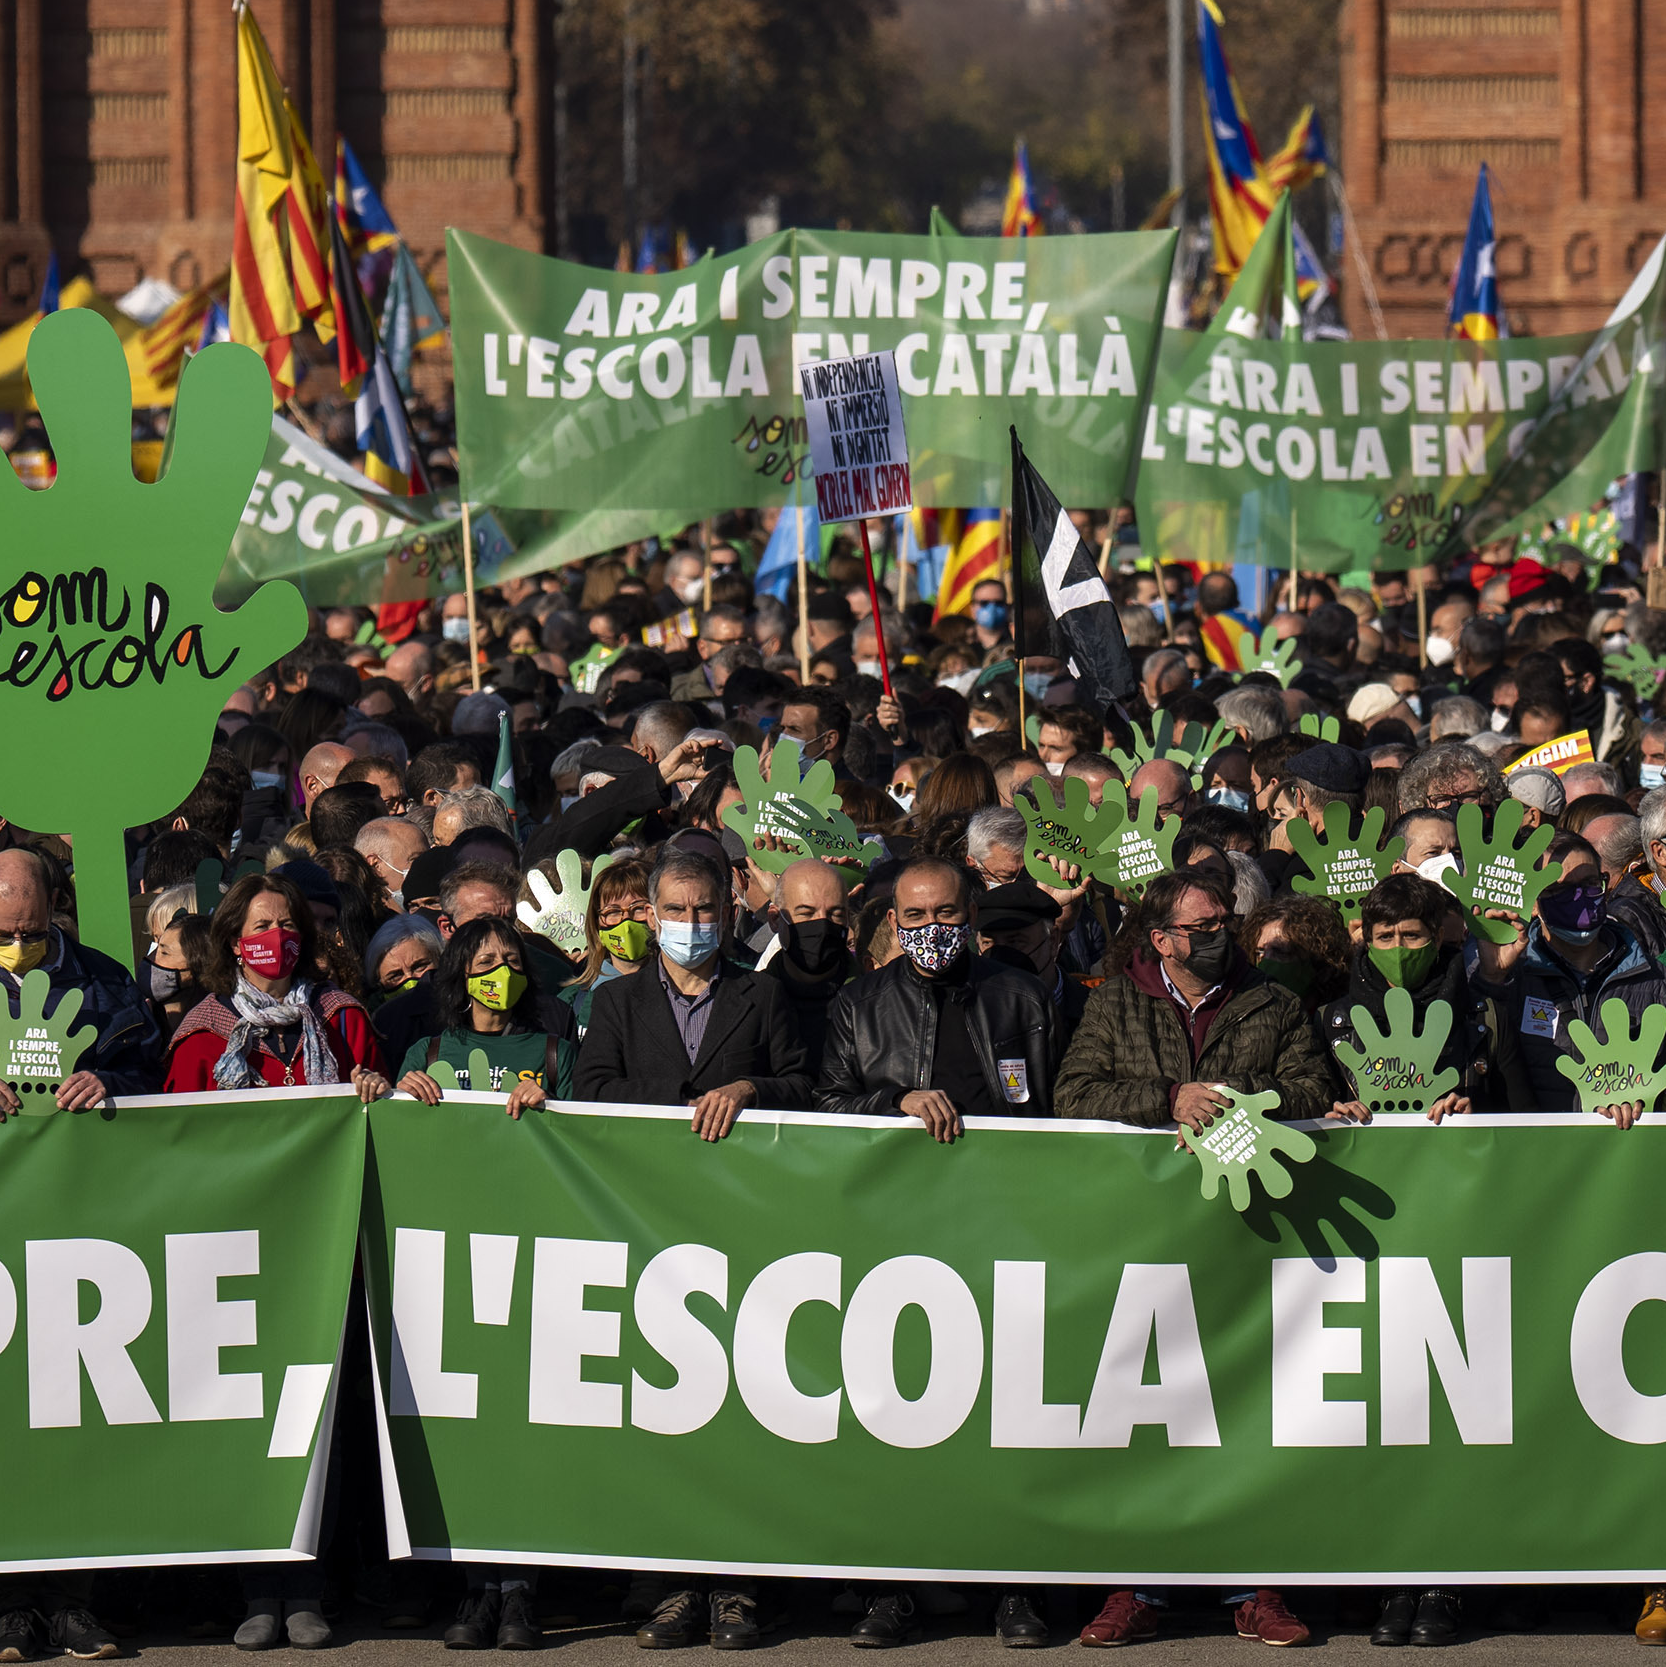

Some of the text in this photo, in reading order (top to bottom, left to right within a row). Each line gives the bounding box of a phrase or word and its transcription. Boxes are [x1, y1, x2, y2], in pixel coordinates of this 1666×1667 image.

[564, 256, 1048, 337] ARA I SEMPRE,
[484, 316, 1137, 399] L'ESCOLA CATALÀ
[1209, 356, 1359, 417] ARA I
[1141, 404, 1392, 481] L'ESCOLA
[1410, 424, 1487, 478] EN
[754, 823, 768, 834] EN
[1030, 816, 1072, 841] som
[1121, 829, 1141, 844] ARA
[1038, 830, 1095, 859] escola
[1118, 838, 1157, 857] SEMPRE,
[1337, 848, 1360, 861] ARA
[1118, 850, 1158, 870] L'ESCOLA
[1118, 858, 1165, 882] EN CATALÀ
[1324, 857, 1376, 873] I SEMPRE,
[1494, 855, 1515, 869] ARA
[1328, 869, 1375, 884] L'ESCOLA
[1483, 865, 1527, 886] SEMPRE,
[1326, 885, 1340, 896] EN
[1478, 877, 1522, 896] L'ESCOLA
[1472, 888, 1524, 909] EN CATALÀ
[25, 1027, 48, 1039] ARA
[16, 1039, 62, 1054] SEMPRE,
[11, 1052, 59, 1065] L'ESCOLA
[1358, 1055, 1406, 1075] som
[6, 1064, 62, 1077] EN CATALÀ
[1370, 1061, 1434, 1091] escola
[1578, 1060, 1625, 1083] som
[1591, 1064, 1654, 1095] escola
[1201, 1107, 1248, 1151] EN CATALÀ
[1212, 1118, 1252, 1156] L'ESCOLA
[1217, 1130, 1256, 1165] SEMPRE,
[1235, 1144, 1257, 1165] ARA
[389, 1227, 1222, 1449] L'ESCOLA
[1271, 1255, 1513, 1447] EN
